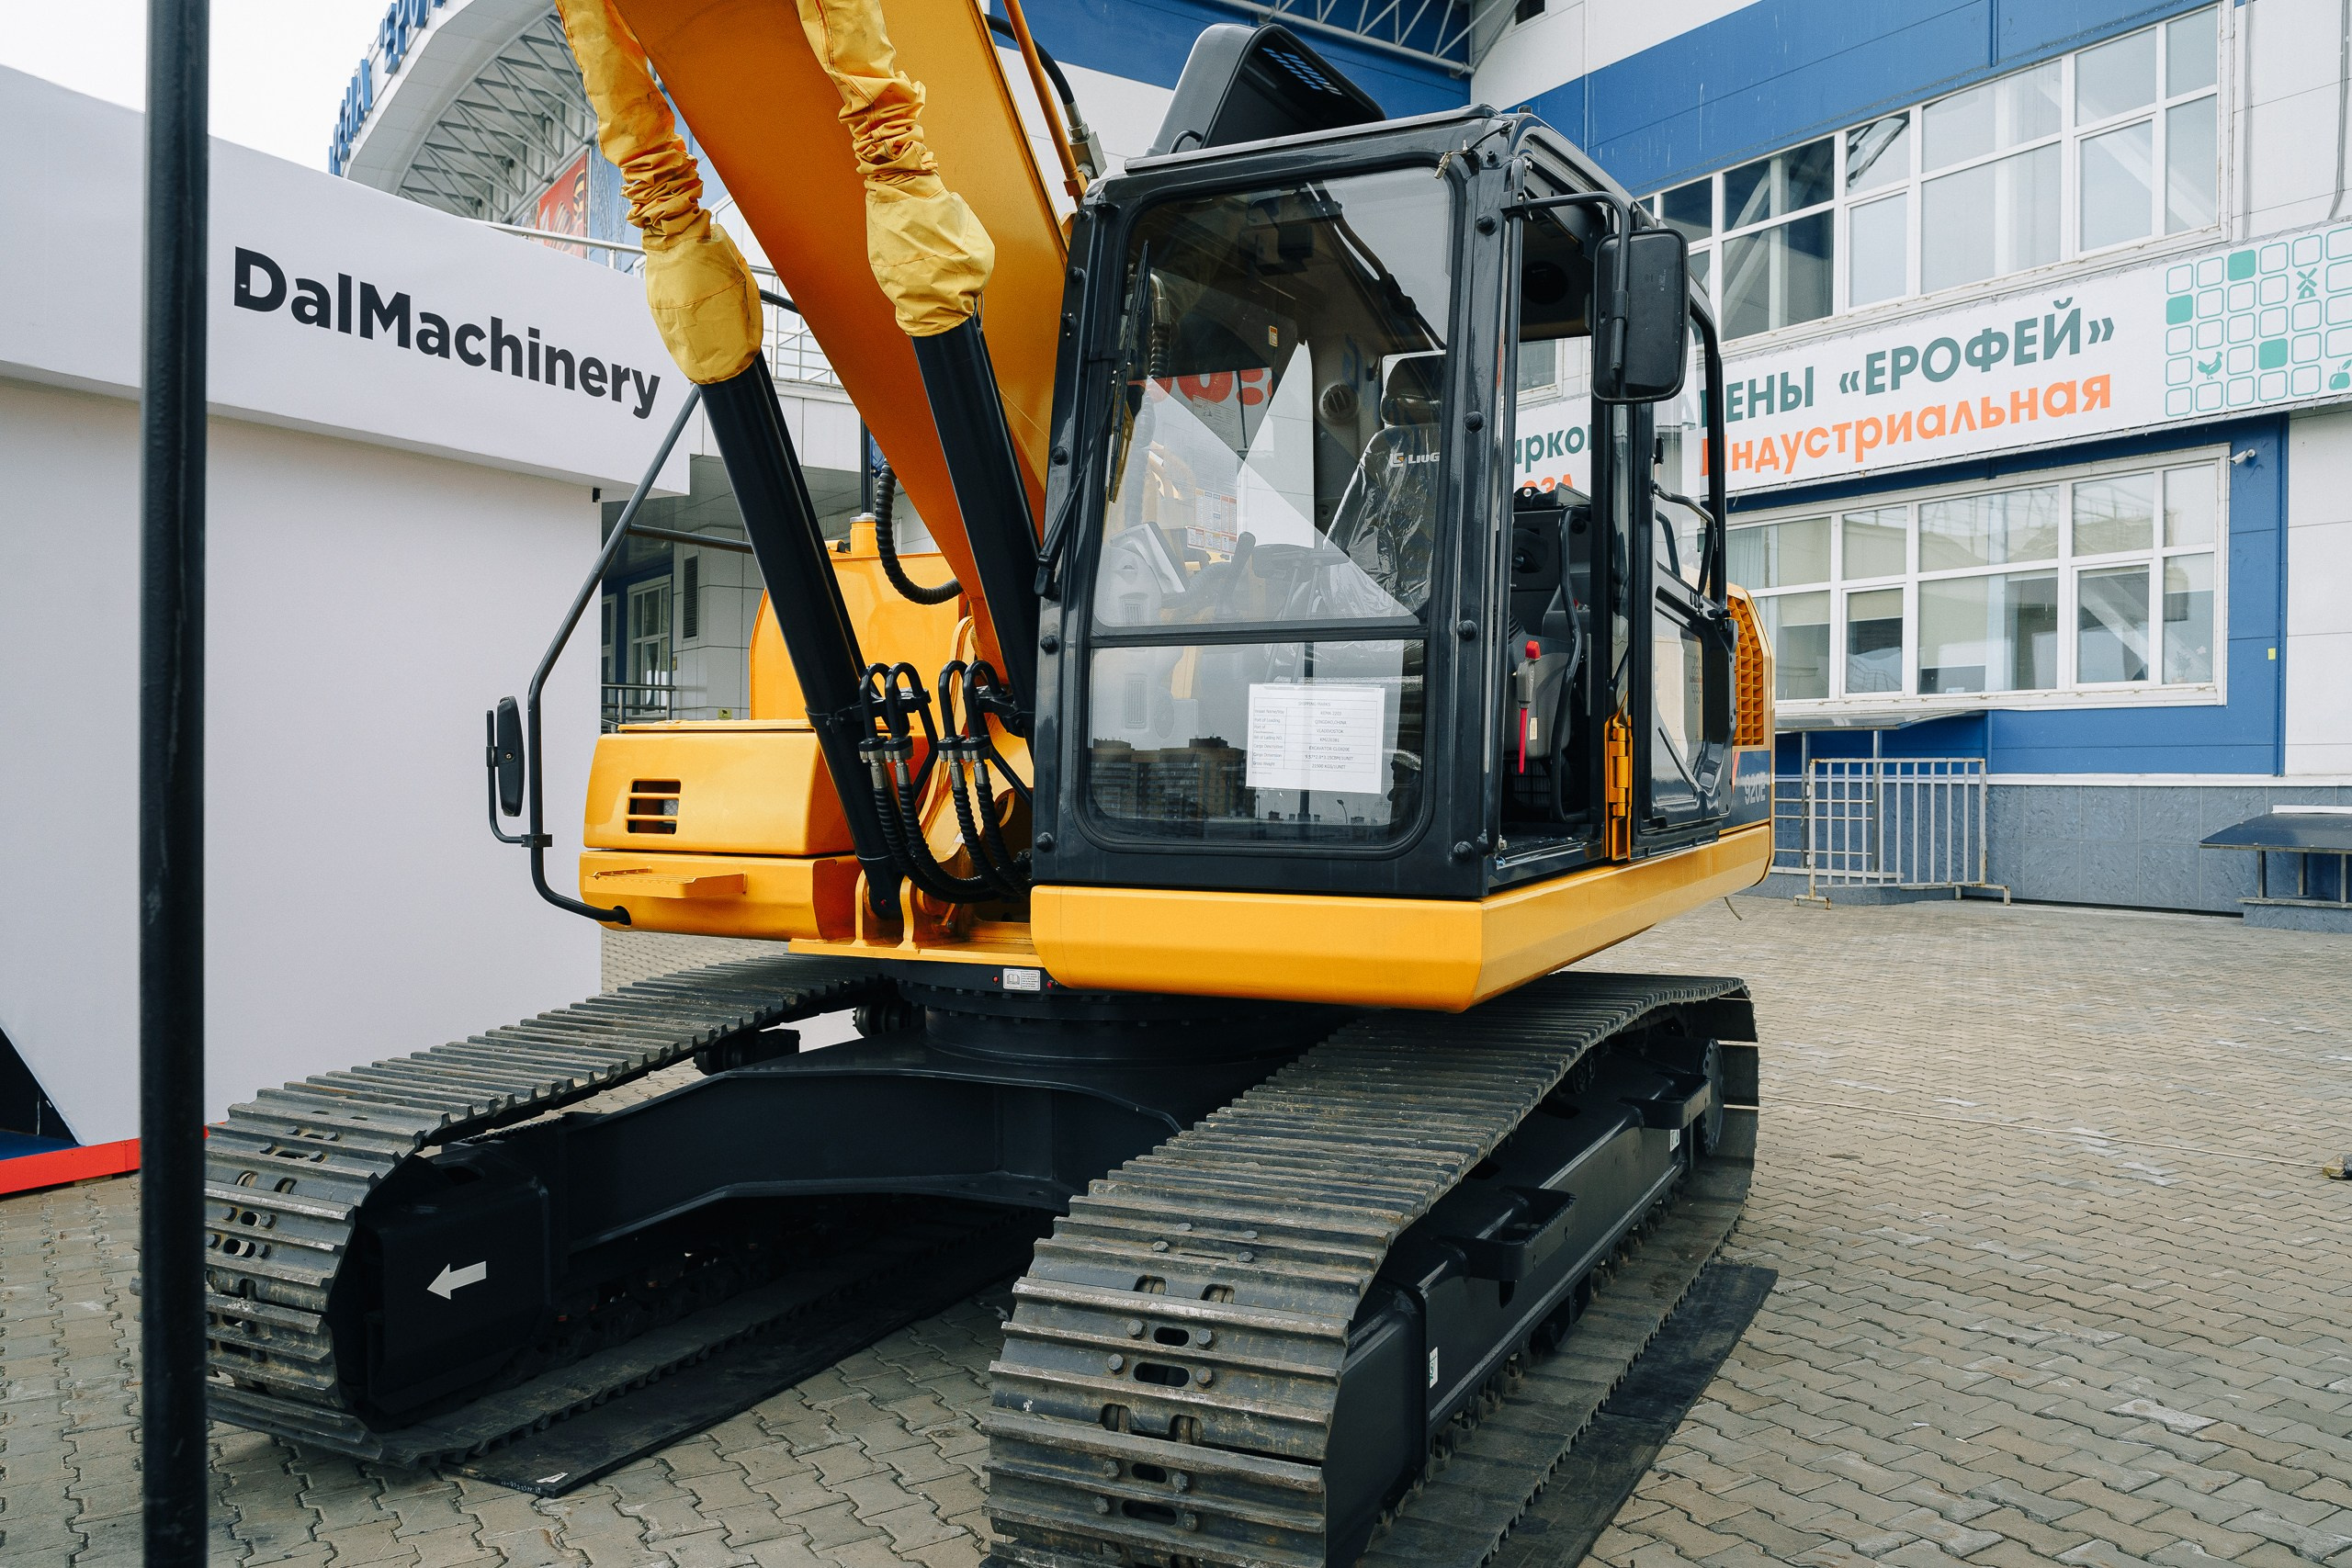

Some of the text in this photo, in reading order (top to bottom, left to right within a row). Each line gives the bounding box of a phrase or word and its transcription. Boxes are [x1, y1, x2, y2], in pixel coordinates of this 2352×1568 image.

[234, 246, 661, 419] DalMachinery
[1839, 297, 2114, 395] «ЕРОФЕЙ»
[1745, 773, 1765, 805] 920E
